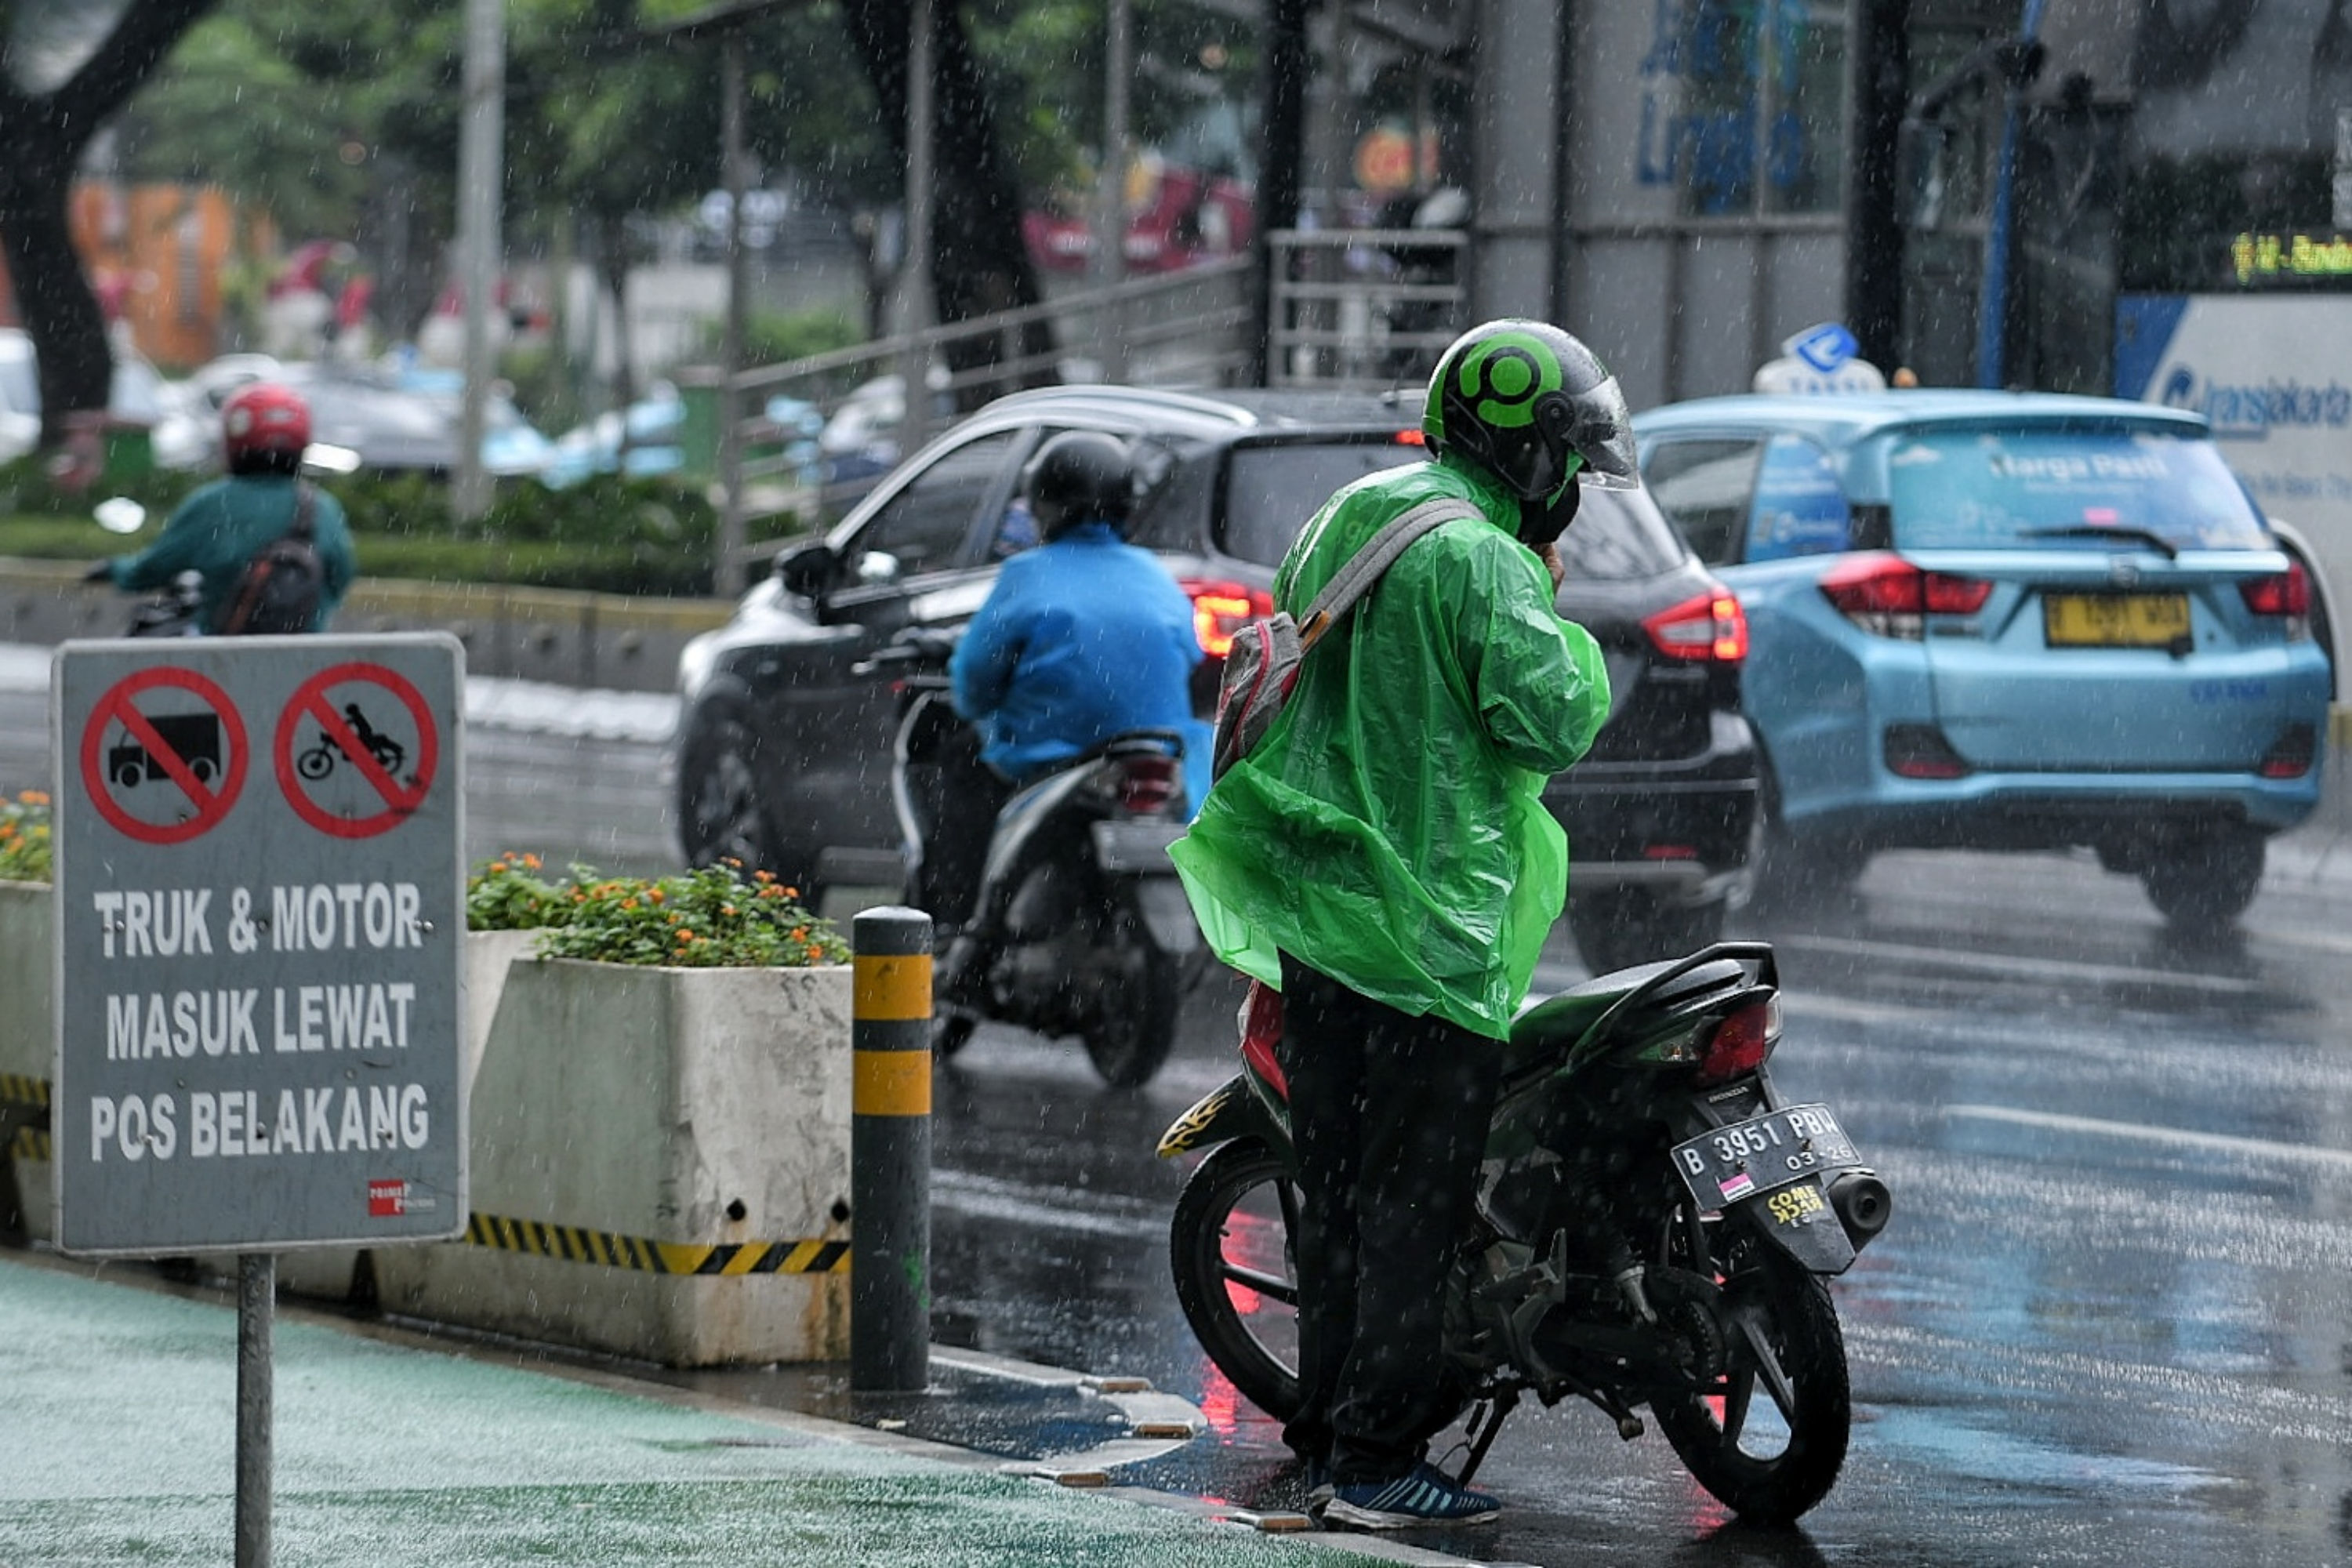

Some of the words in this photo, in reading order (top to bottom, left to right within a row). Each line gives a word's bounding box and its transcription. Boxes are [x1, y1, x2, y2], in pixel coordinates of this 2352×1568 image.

[94, 889, 213, 958] TRUK
[228, 887, 258, 953] &
[273, 882, 423, 951] MOTOR
[107, 989, 260, 1060] MASUK
[274, 982, 416, 1052] LEWAT
[91, 1094, 176, 1162] POS
[191, 1083, 429, 1158] BELAKANG
[1708, 1086, 1749, 1104] HONDA
[1682, 1148, 1704, 1175] B
[1714, 1121, 1781, 1162] 3951
[1787, 1109, 1839, 1138] PBW
[1768, 1185, 1818, 1210] COME
